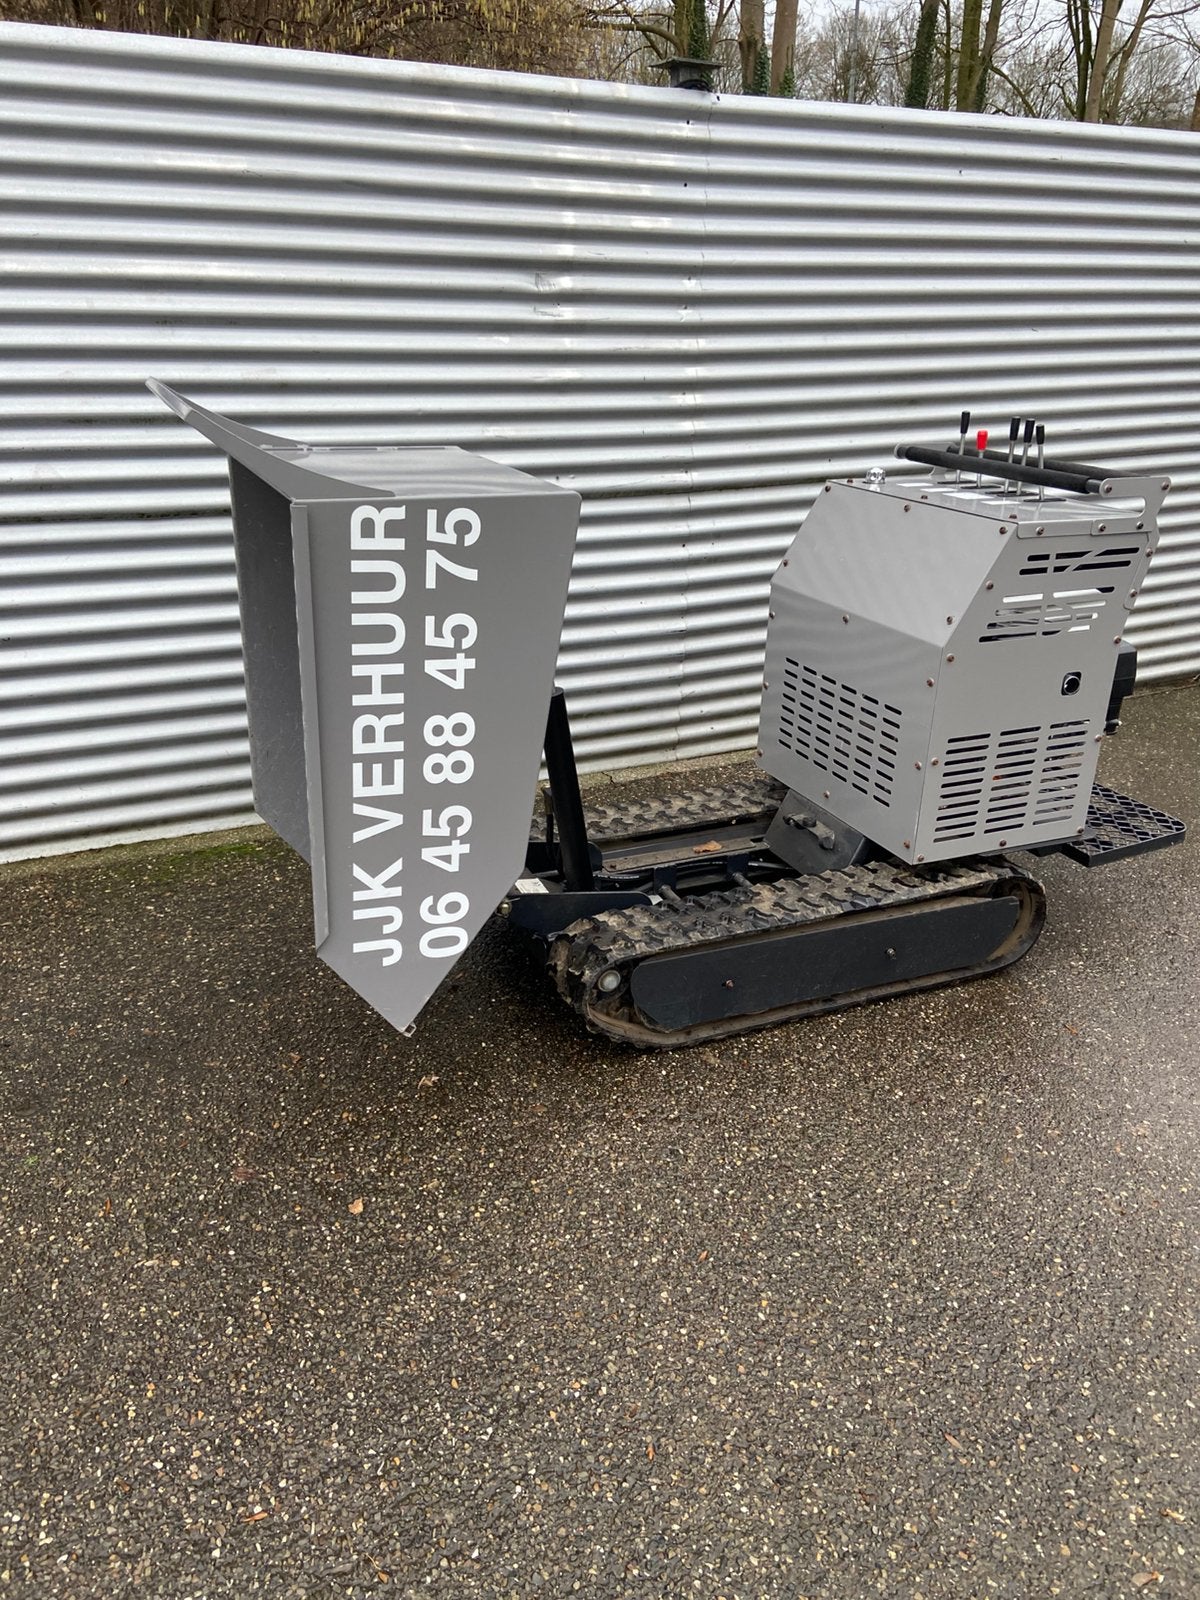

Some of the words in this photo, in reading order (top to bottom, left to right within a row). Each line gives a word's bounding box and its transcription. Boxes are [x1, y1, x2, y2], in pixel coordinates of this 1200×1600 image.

[425, 507, 482, 589] 75
[350, 504, 407, 844] VERHUUR
[424, 612, 478, 690] 45
[422, 711, 476, 785] 88
[420, 804, 473, 873] 45
[352, 856, 404, 968] JJK
[418, 891, 470, 959] 06
